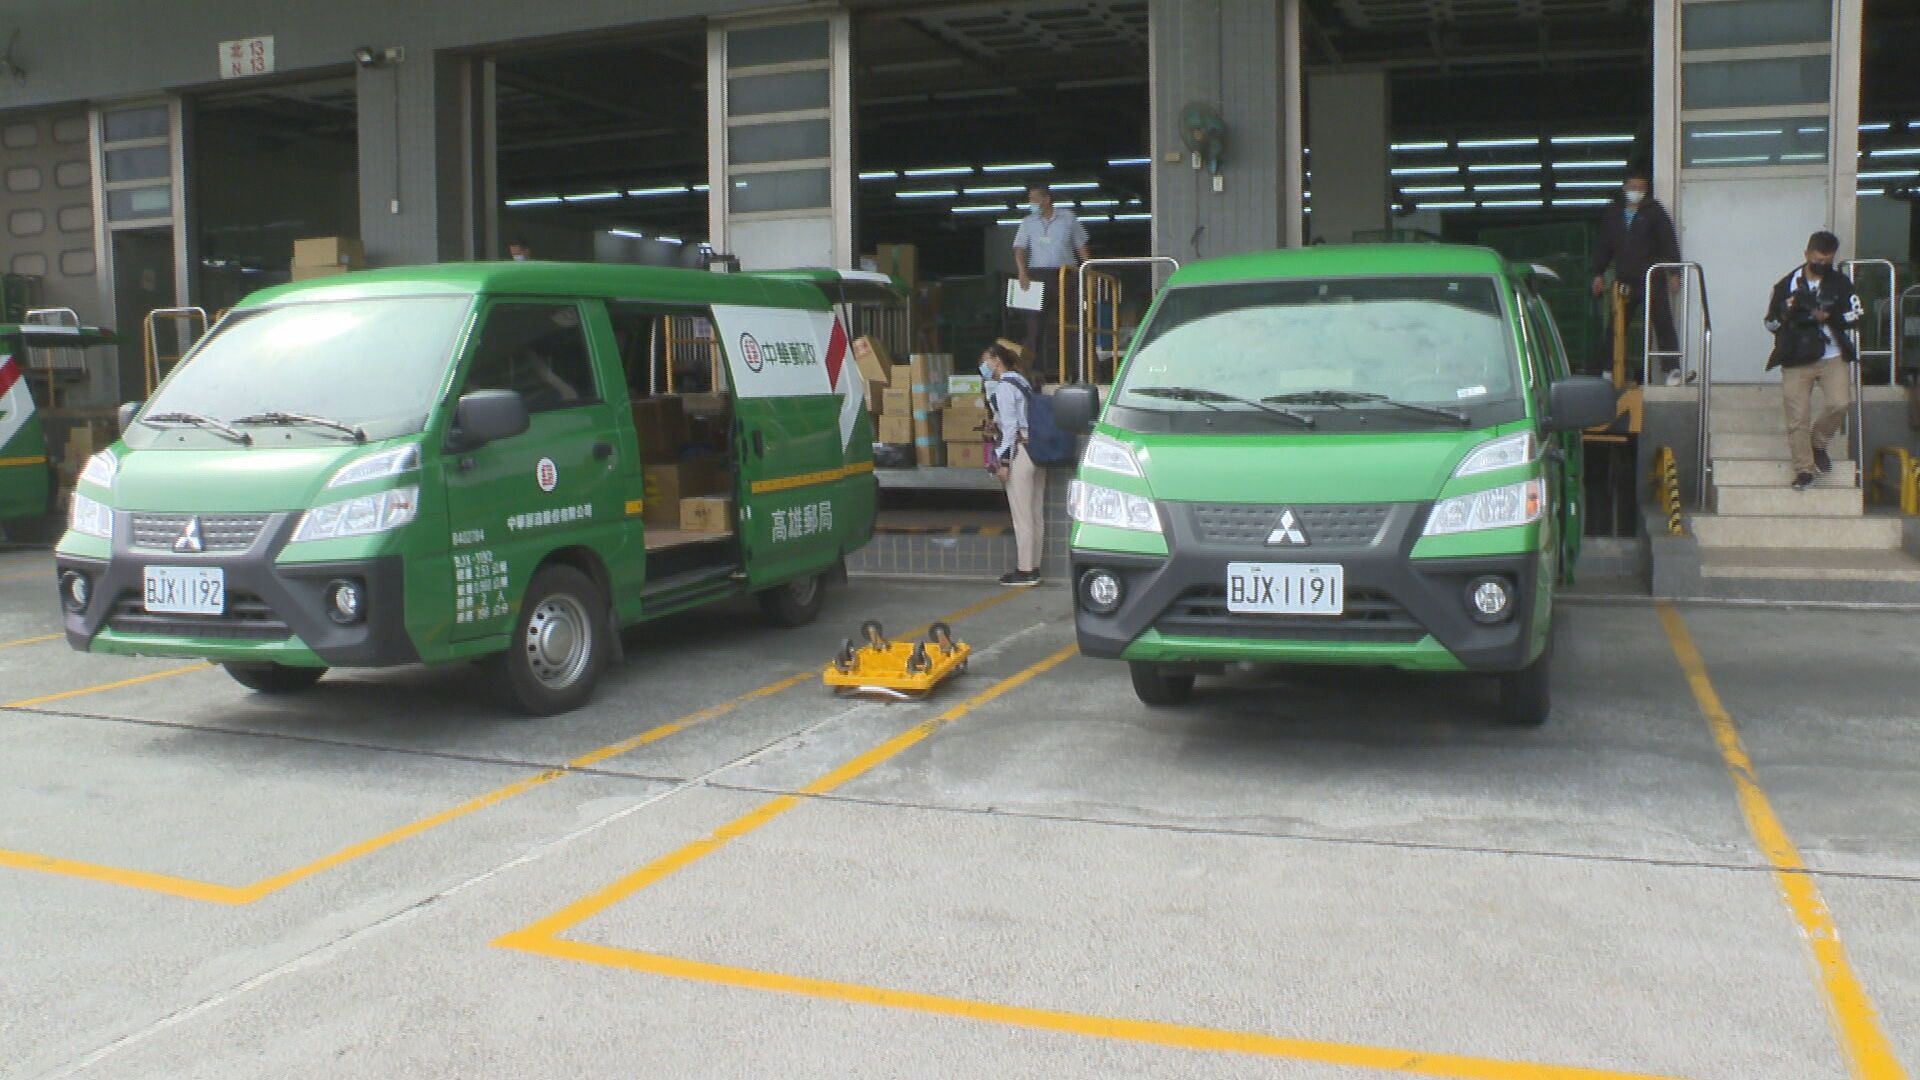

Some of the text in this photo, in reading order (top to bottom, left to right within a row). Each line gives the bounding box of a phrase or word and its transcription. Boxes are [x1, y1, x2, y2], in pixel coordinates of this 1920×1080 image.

[230, 40, 264, 57] 北 13
[232, 57, 264, 76] N 13
[761, 341, 817, 366] 中華郵政
[771, 500, 833, 543] 高雄郵局
